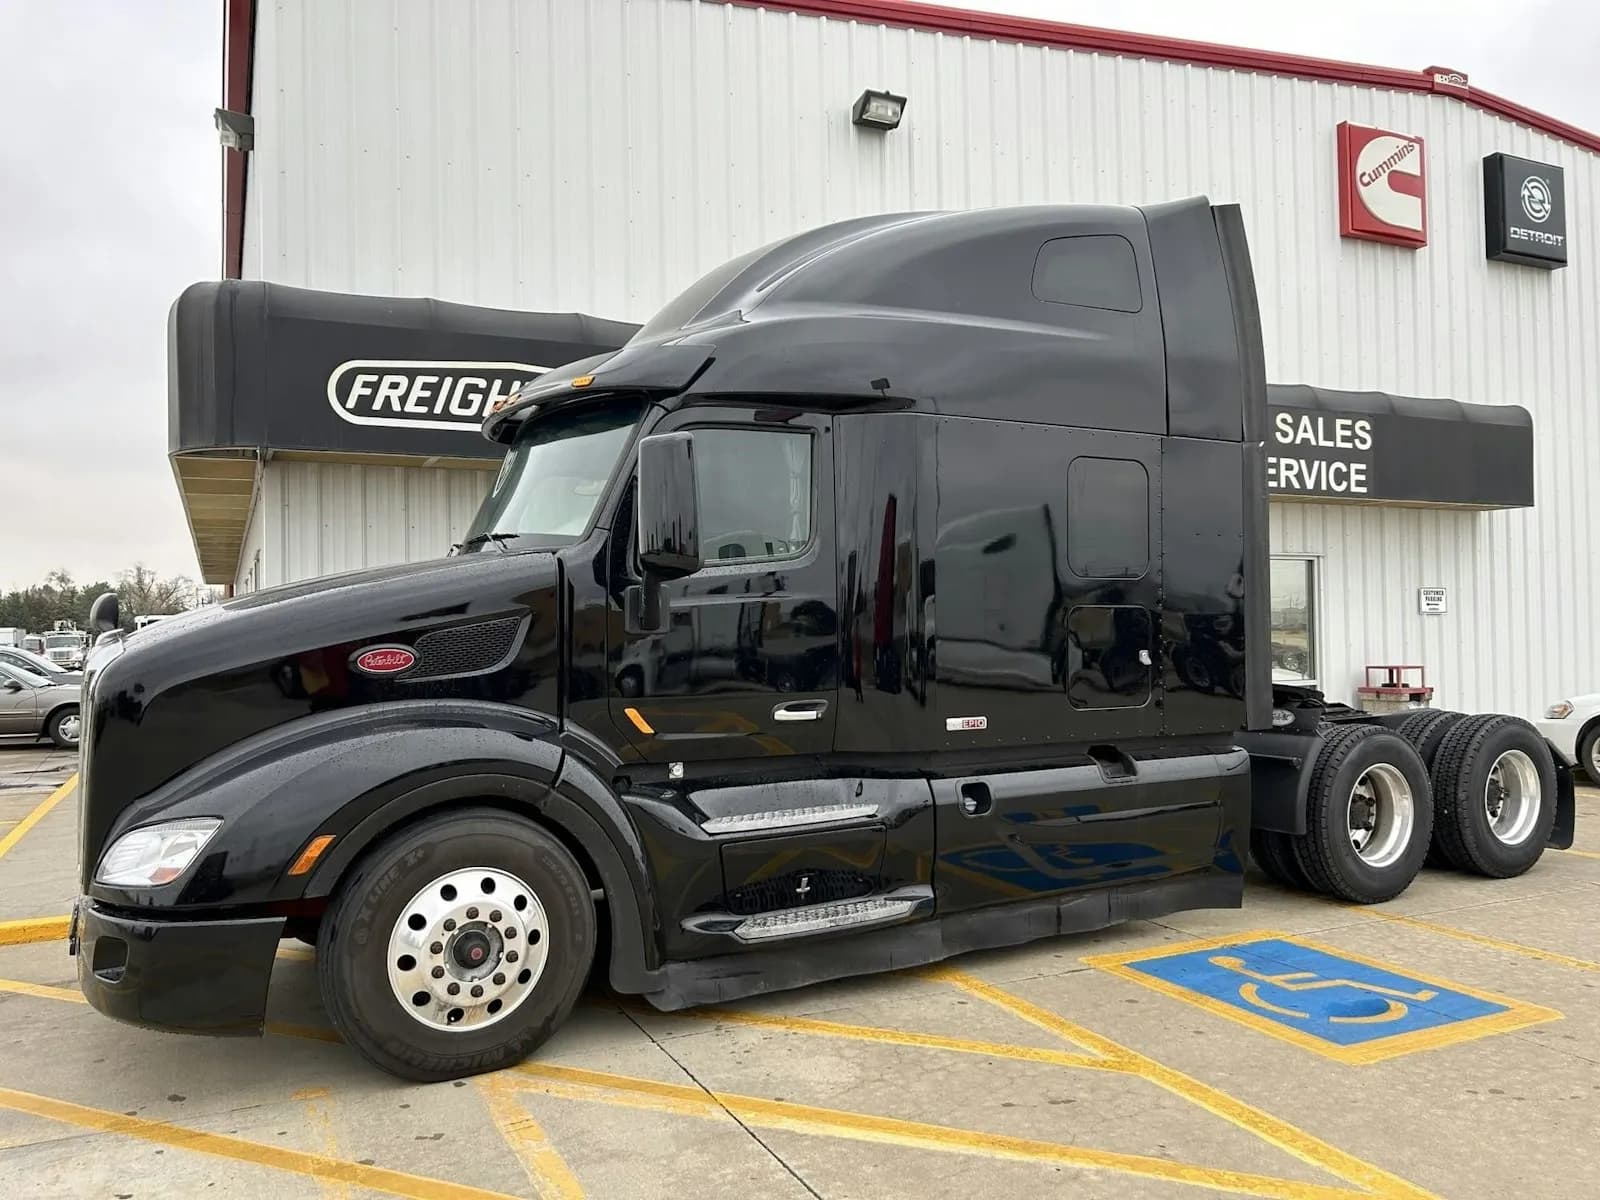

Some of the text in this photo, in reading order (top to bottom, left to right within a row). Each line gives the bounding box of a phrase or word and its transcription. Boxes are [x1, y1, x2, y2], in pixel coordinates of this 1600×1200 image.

[1359, 141, 1415, 187] Cummins
[1510, 226, 1564, 246] DETROIT
[345, 374, 530, 418] FREIGH
[1275, 412, 1372, 450] SALES
[1267, 456, 1368, 493] ERVICE
[364, 653, 409, 668] Peterbilt
